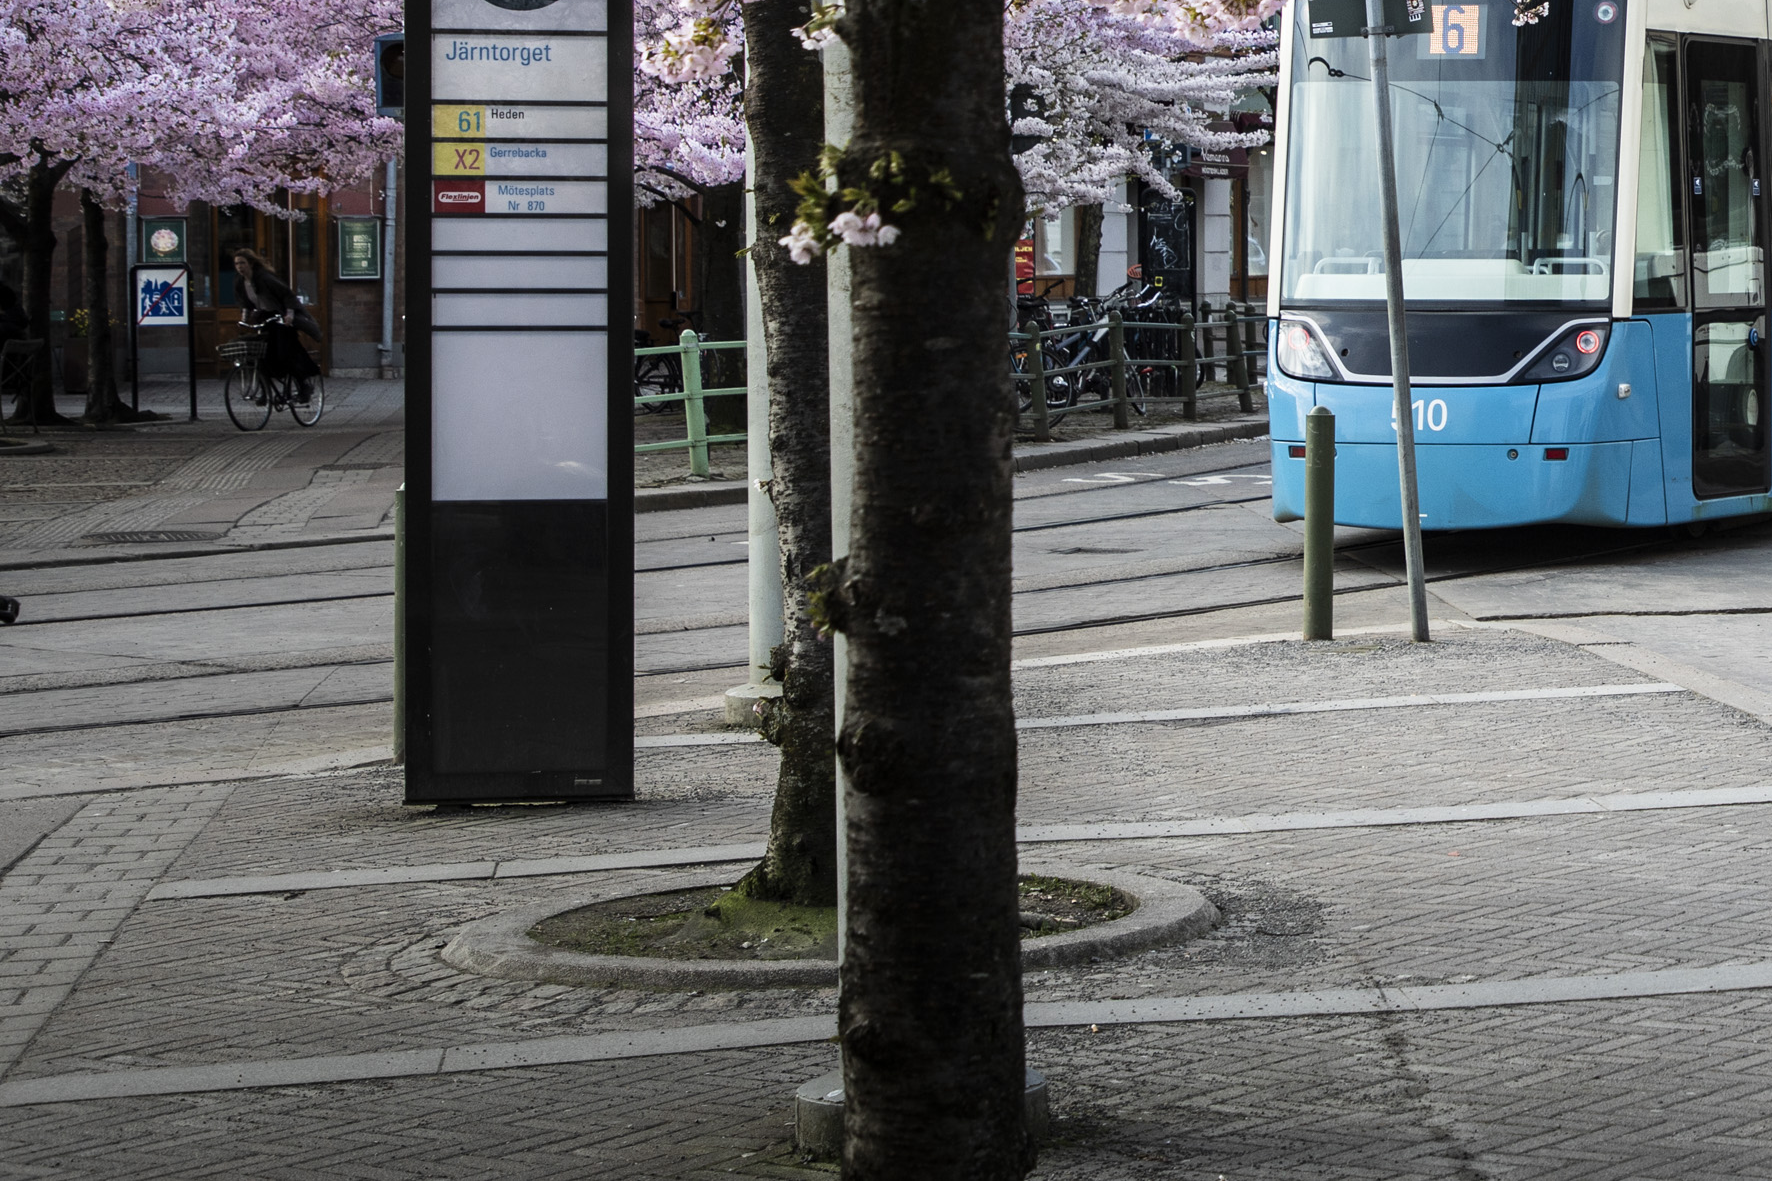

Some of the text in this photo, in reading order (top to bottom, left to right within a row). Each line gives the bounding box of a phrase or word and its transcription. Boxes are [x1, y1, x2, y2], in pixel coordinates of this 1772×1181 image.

[1442, 6, 1465, 54] 6
[446, 41, 552, 66] Järntorget
[458, 108, 525, 133] 61 Heden
[454, 147, 547, 170] X2 Gerrebacka
[440, 185, 555, 201] Flexlinjen Mötesplats
[508, 201, 545, 211] Nr 870
